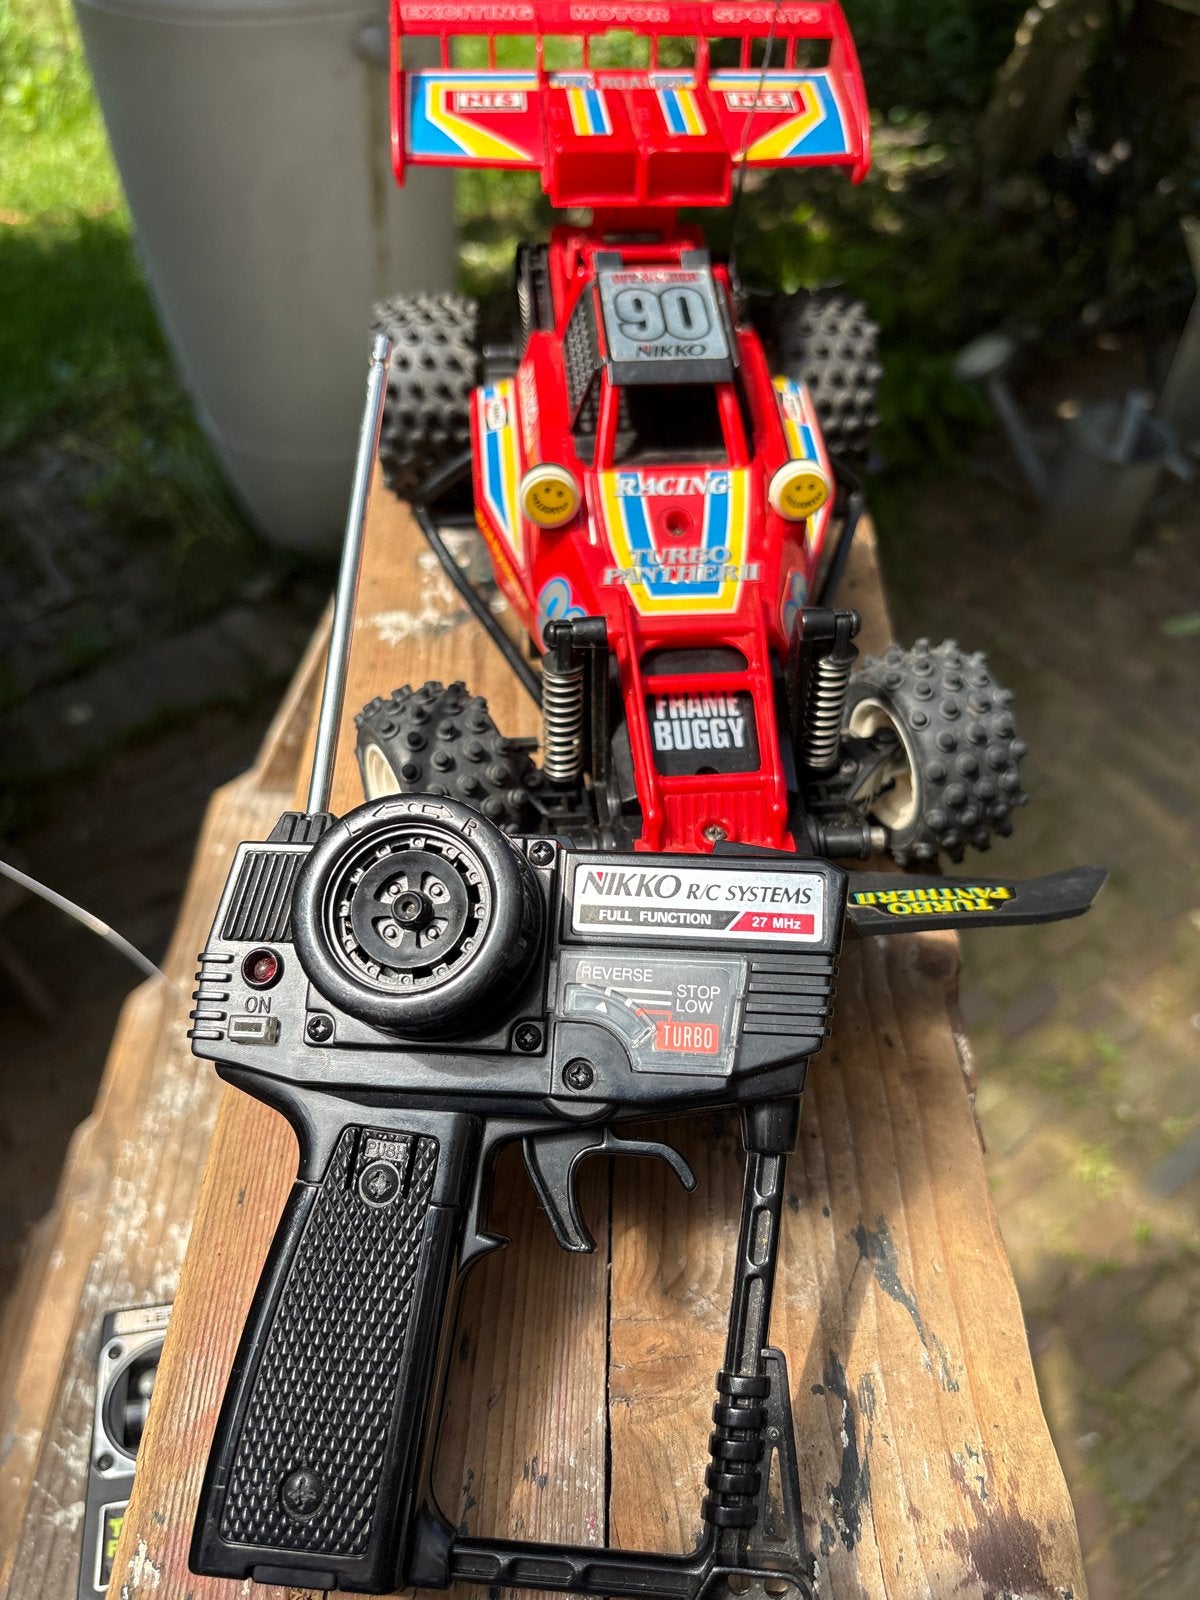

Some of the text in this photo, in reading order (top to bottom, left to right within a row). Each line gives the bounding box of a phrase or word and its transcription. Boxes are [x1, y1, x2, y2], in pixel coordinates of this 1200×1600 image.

[400, 3, 821, 24] EXCITING MOTOR SPORTS
[613, 287, 711, 342] 90
[636, 344, 706, 358] NIKKO
[615, 475, 729, 496] RACING
[631, 546, 731, 565] TURBO
[655, 695, 741, 719] FRAME
[653, 717, 744, 751] BUGGY
[581, 871, 812, 904] NIKKO R/C SYSTEMS
[887, 899, 994, 915] TURBO
[599, 910, 801, 929] FULL FUNCTION 27 MHz
[580, 966, 654, 983] REVERSE
[677, 985, 721, 999] STOP
[244, 996, 272, 1014] ON
[676, 1000, 713, 1014] LOW
[664, 1026, 714, 1048] TURBO
